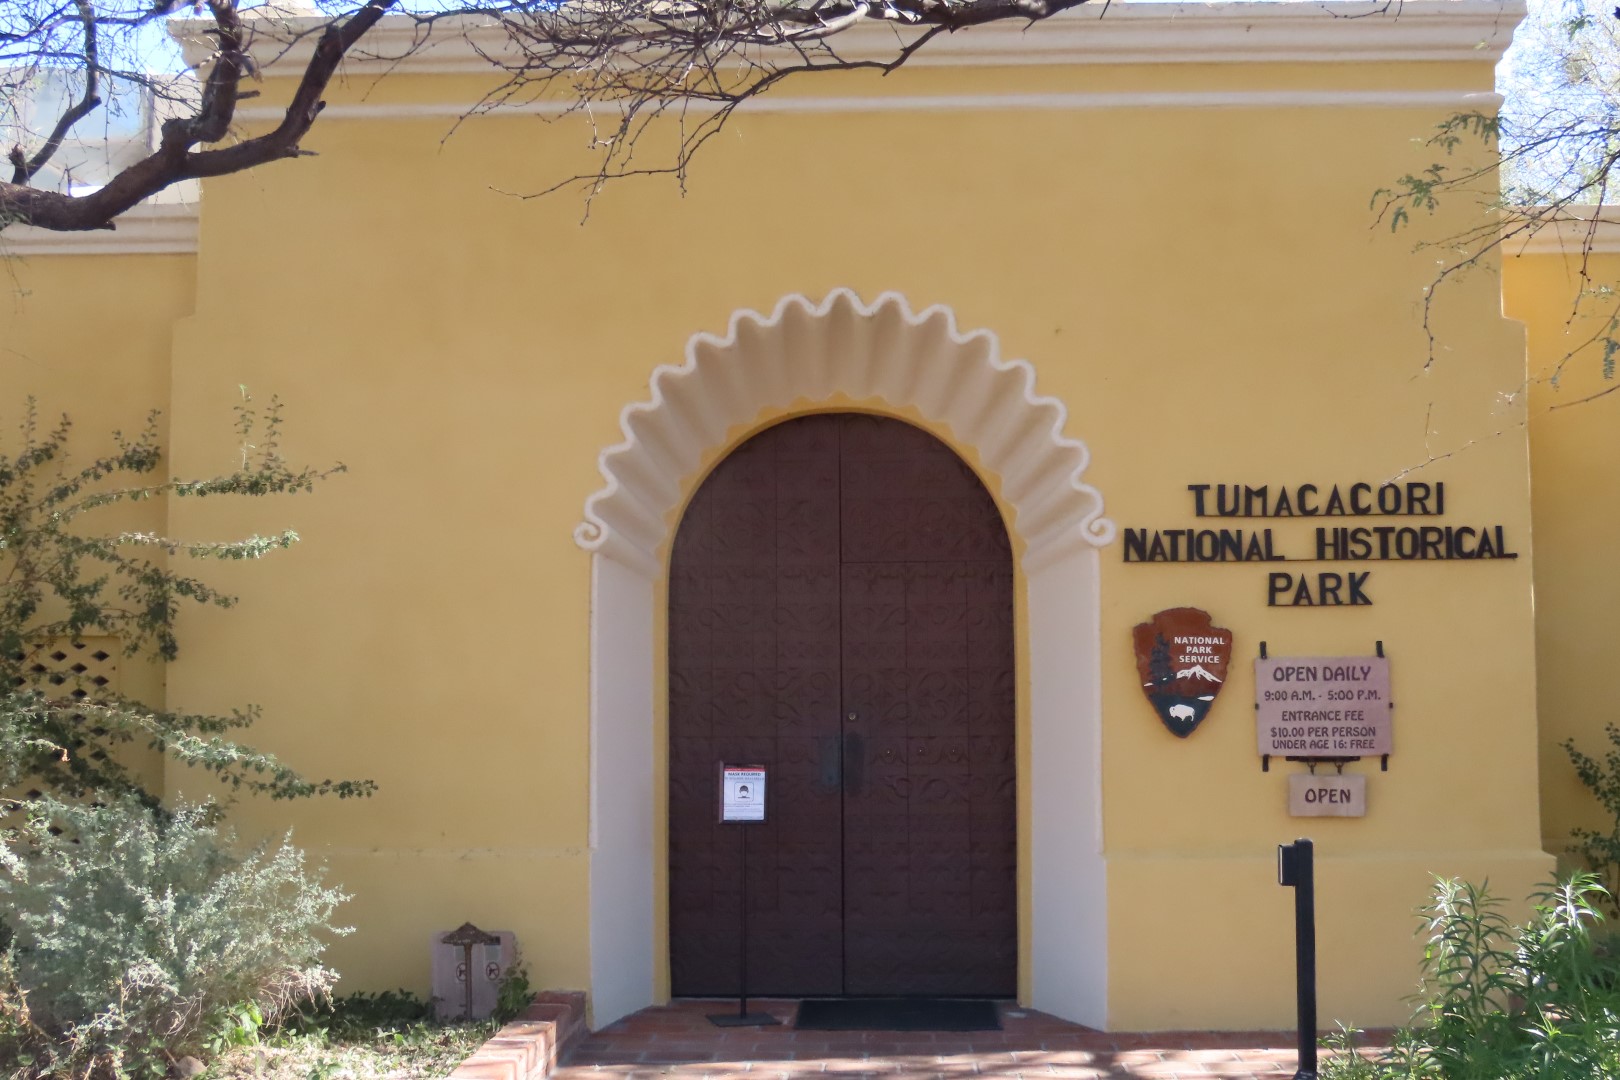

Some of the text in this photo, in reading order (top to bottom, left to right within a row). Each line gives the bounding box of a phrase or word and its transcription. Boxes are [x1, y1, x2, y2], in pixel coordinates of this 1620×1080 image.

[1187, 482, 1444, 517] TUMACACORI
[1123, 525, 1518, 562] NATIONAL HISTORICAL
[1268, 571, 1373, 606] PARK
[1174, 636, 1225, 645] NATIONAL
[1186, 646, 1212, 654] PARK
[1179, 655, 1220, 664] SERVICE
[1273, 666, 1371, 682] OPEN DAILY
[1264, 690, 1288, 701] 9:00
[1291, 690, 1316, 701] A.M.
[1327, 690, 1354, 701] 5:00
[1357, 690, 1381, 700] P.M.
[1281, 710, 1365, 721] ENTRANCE FEE
[1270, 726, 1376, 738] $10.00 PER PERSON
[1272, 739, 1375, 749] UNDER AGE 16: FREE
[1304, 788, 1351, 803] OPEN
